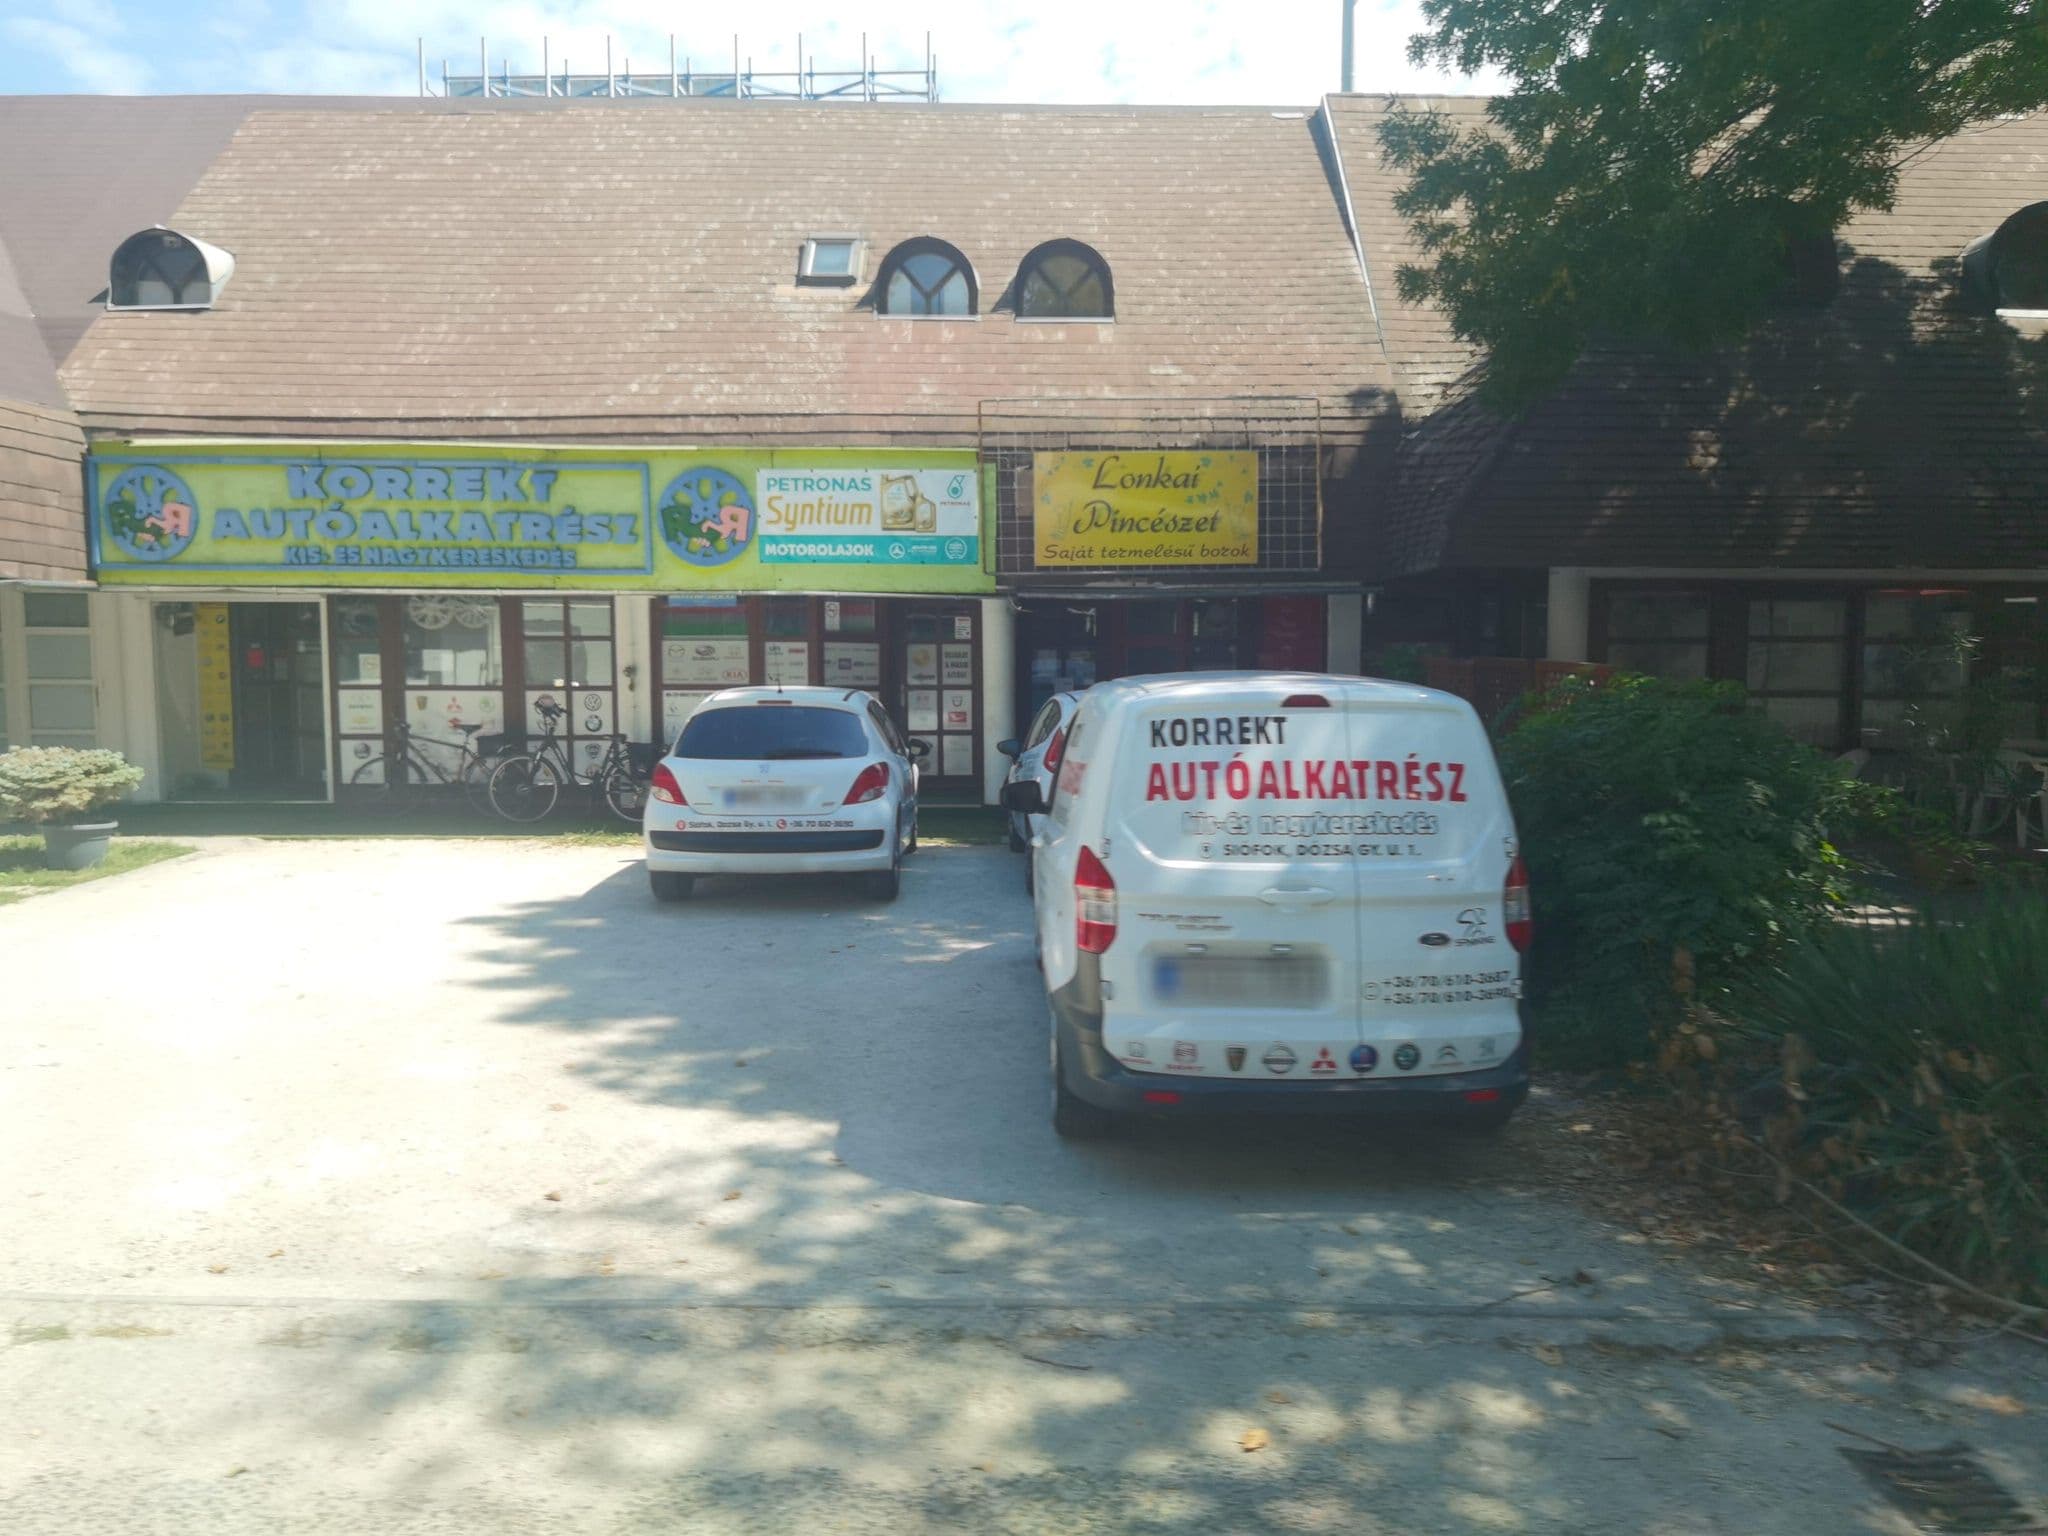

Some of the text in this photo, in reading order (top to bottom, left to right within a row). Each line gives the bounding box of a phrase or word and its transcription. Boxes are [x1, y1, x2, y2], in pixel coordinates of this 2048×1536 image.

[286, 465, 560, 500] KORREKT
[766, 477, 873, 492] PETRONAS
[1092, 455, 1201, 490] Lonkai
[211, 501, 640, 545] AUTÓALKATRÉSZ
[766, 496, 873, 532] Syntium
[1072, 499, 1221, 535] Pincészet
[765, 543, 875, 557] MOTOROLAJOK
[1043, 544, 1095, 561] Saját
[1200, 543, 1250, 558] borok
[1150, 715, 1288, 748] KORREKT
[1146, 753, 1468, 802] AUTÓALKATRÉSZ
